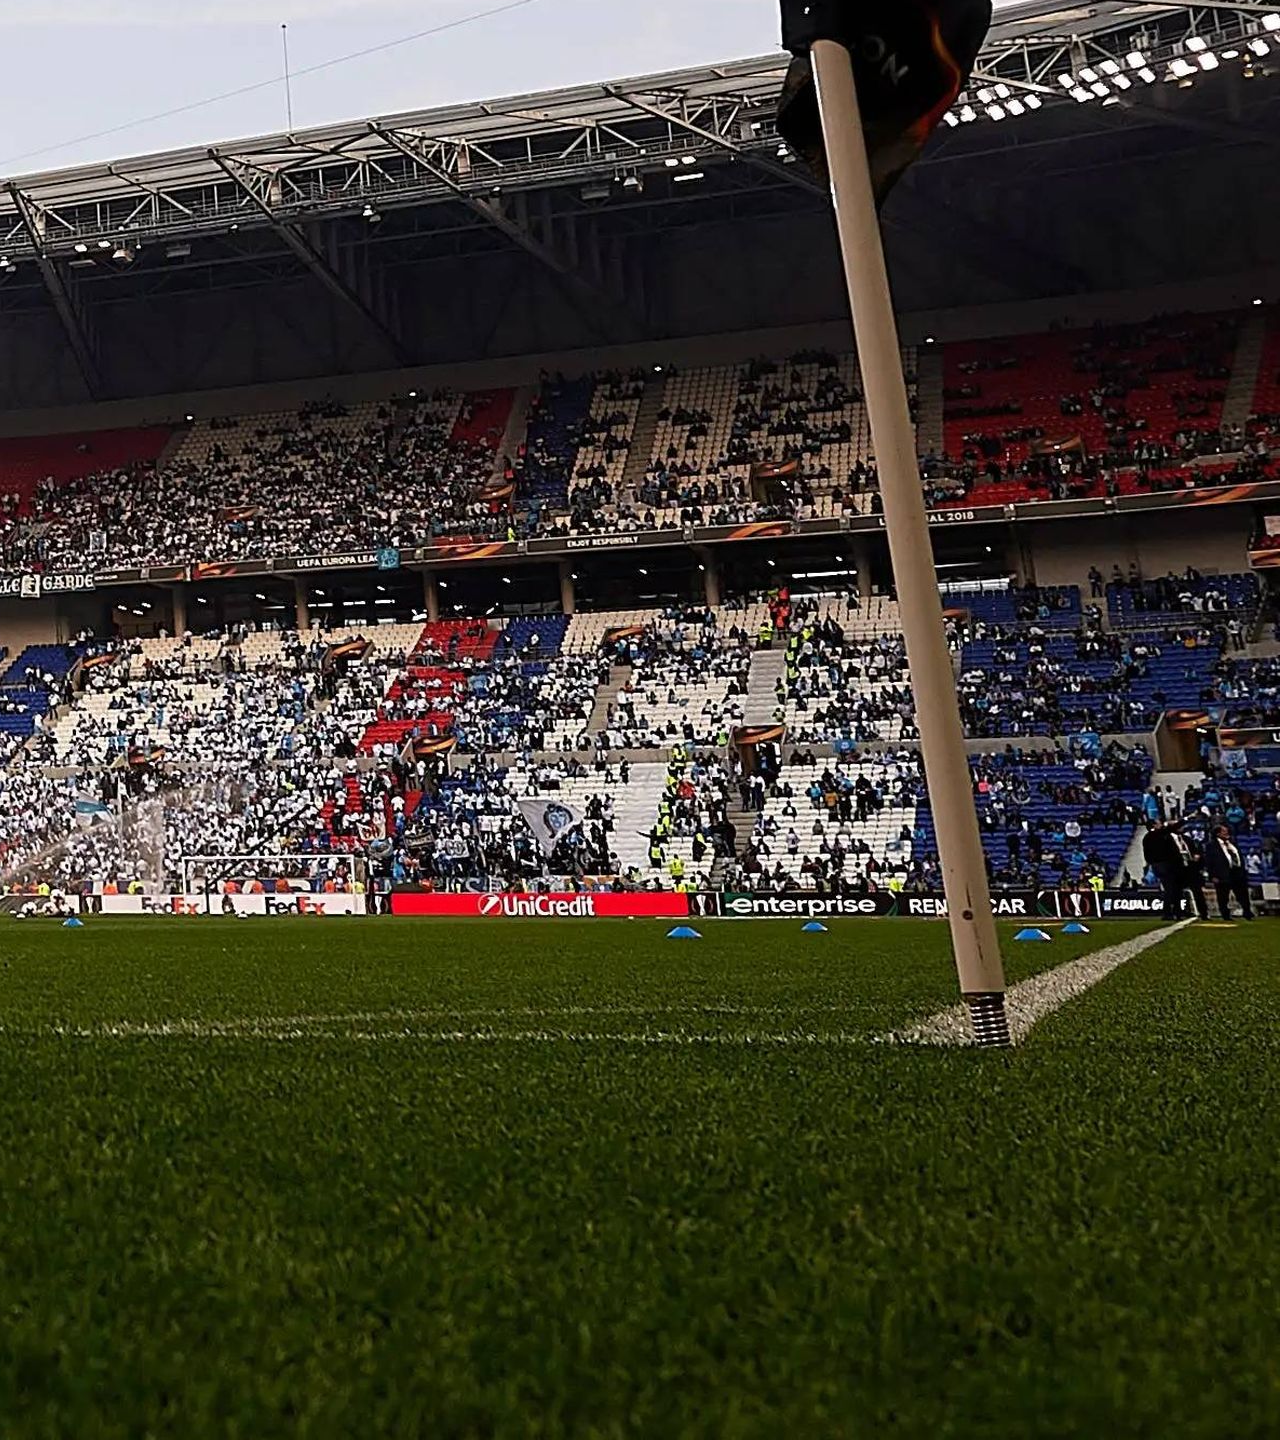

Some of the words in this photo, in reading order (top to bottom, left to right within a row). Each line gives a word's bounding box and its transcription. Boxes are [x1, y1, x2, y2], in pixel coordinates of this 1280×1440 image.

[946, 511, 974, 522] 2018
[297, 558, 321, 568] UEFA
[322, 556, 356, 566] EUROPA
[42, 573, 95, 591] GARDE
[141, 896, 200, 915] FedEx
[265, 896, 326, 915] FedEx
[503, 895, 596, 916] UniCredit
[725, 896, 877, 917] enterprise
